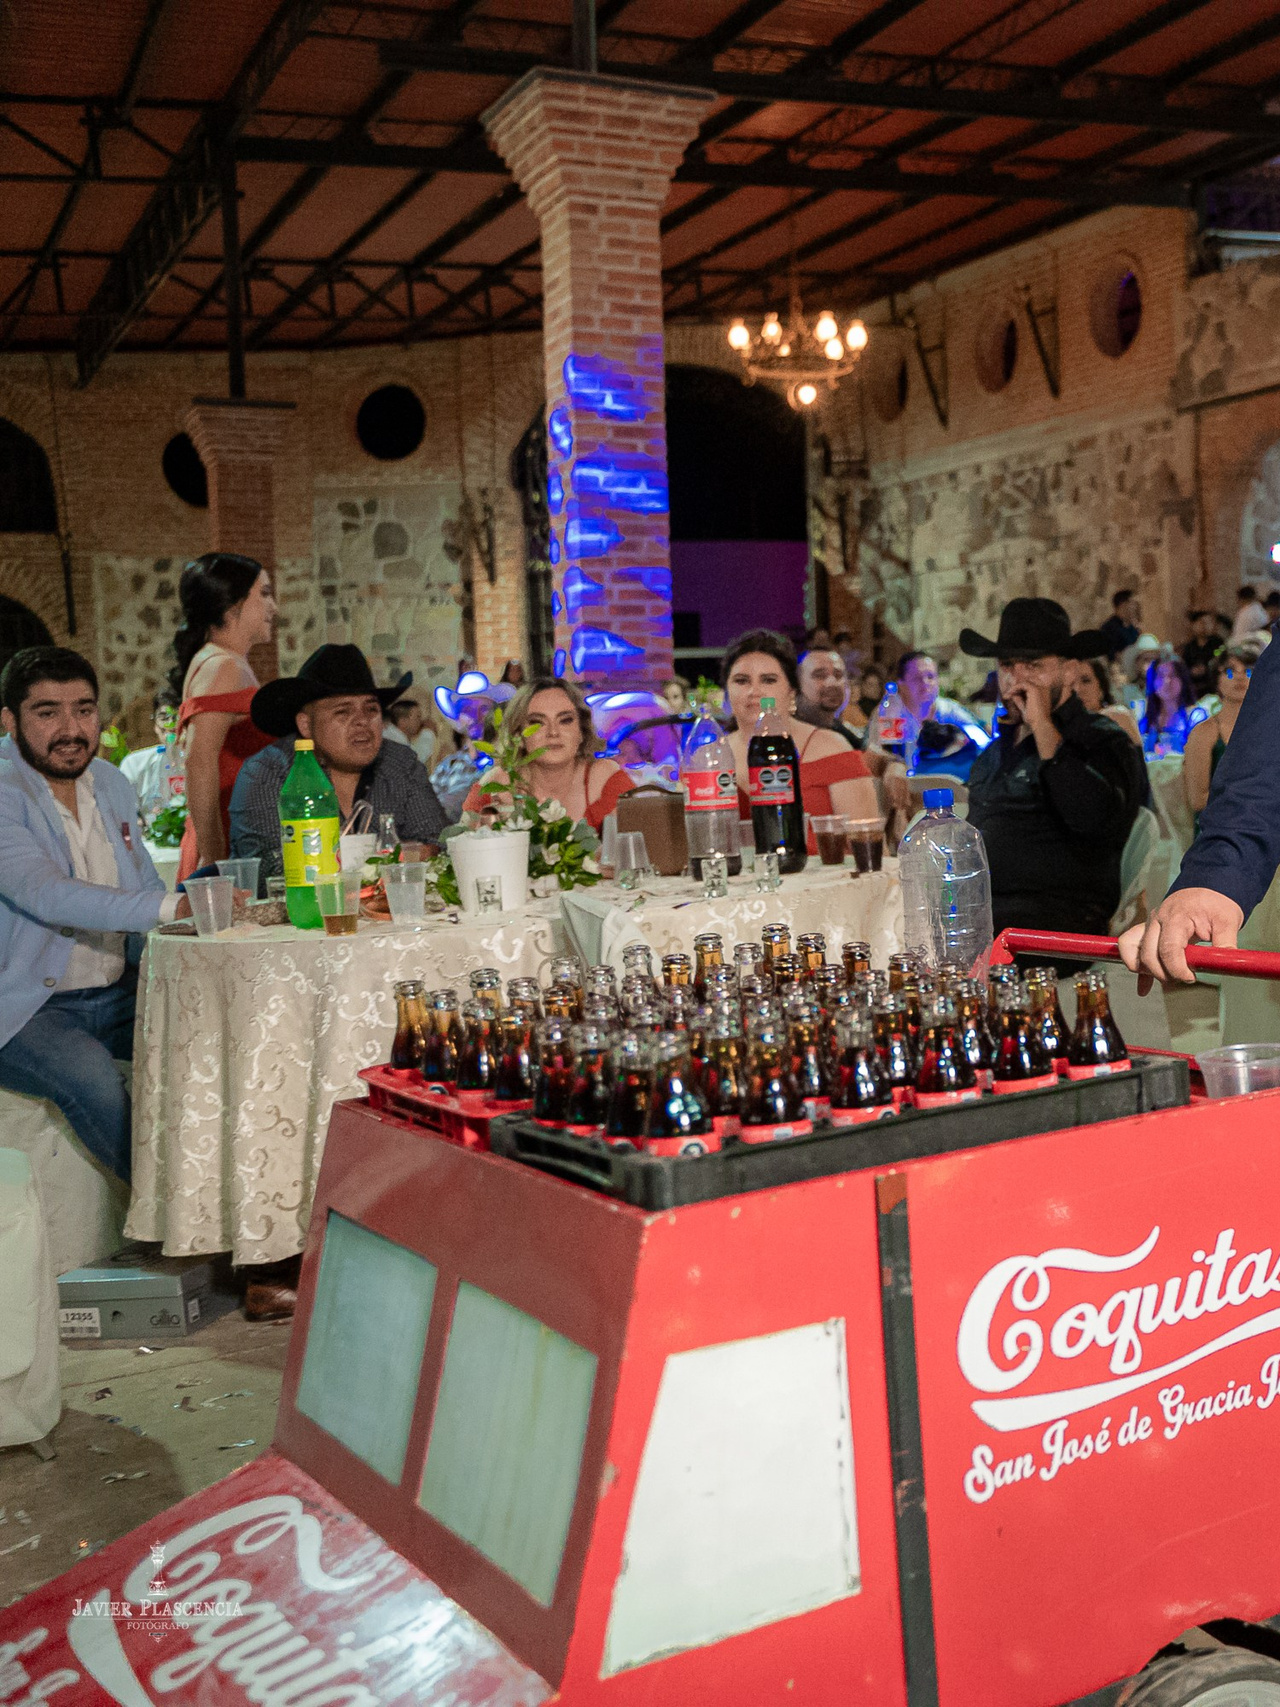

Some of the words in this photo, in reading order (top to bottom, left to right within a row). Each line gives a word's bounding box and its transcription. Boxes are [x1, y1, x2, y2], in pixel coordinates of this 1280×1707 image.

[964, 1445, 1036, 1504] San
[1039, 1419, 1111, 1480] José
[1118, 1407, 1152, 1446] de
[1158, 1382, 1254, 1439] Gracia
